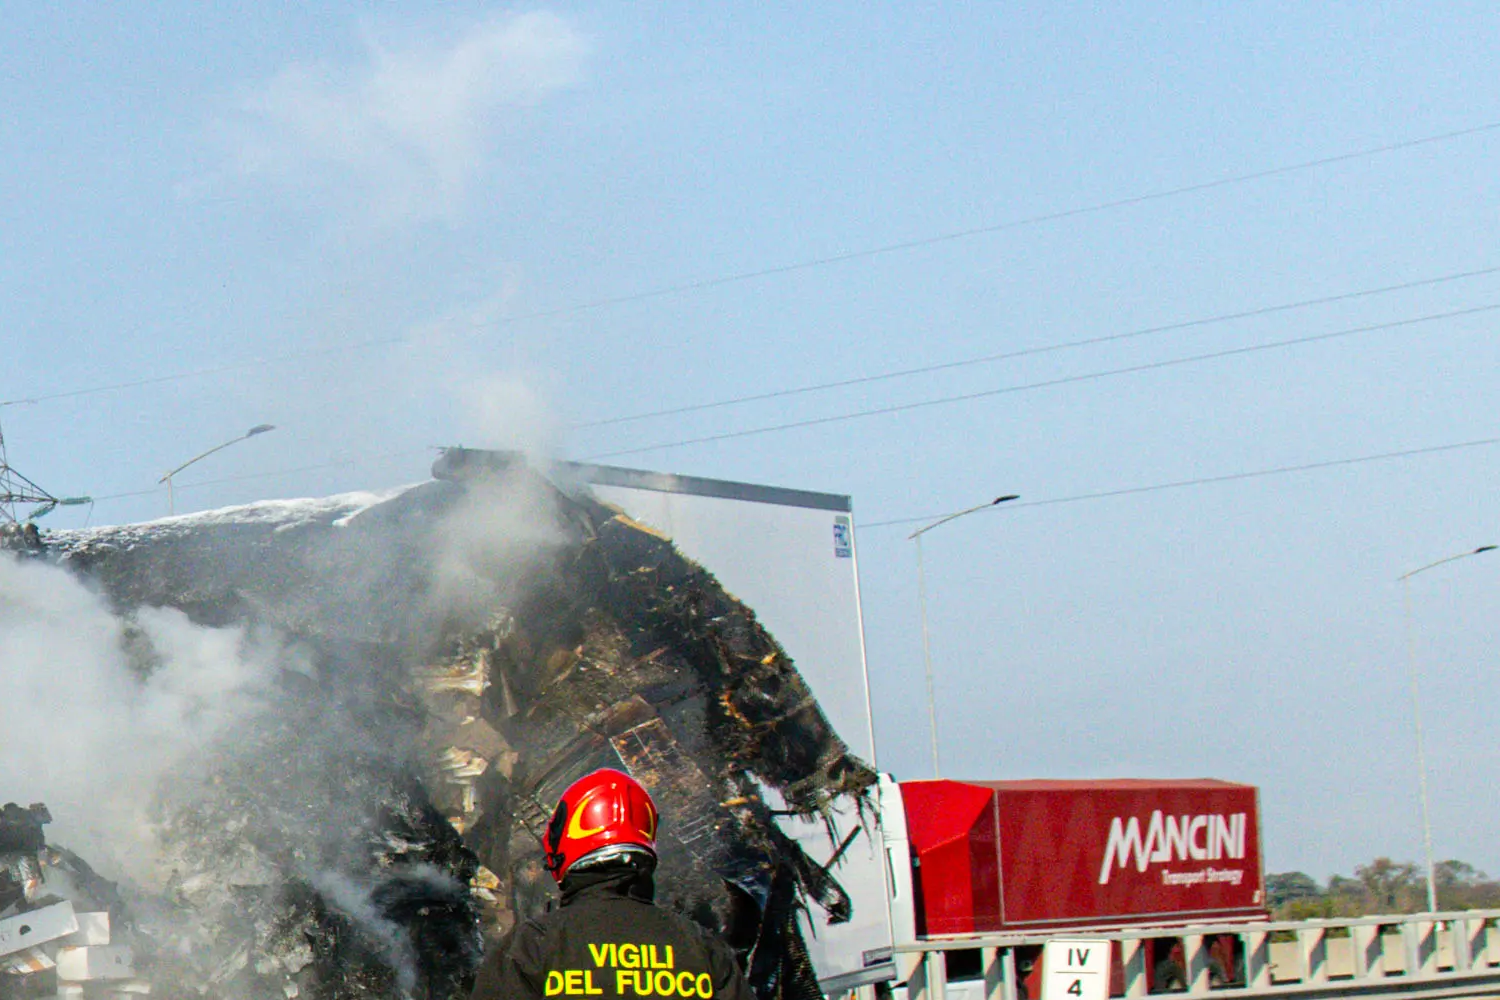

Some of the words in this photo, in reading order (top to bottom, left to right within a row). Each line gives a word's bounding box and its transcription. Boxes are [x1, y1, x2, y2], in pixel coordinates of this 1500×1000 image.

[1099, 809, 1247, 885] MANCINI
[587, 942, 675, 970] VIGILI
[1067, 947, 1092, 967] IV
[544, 969, 604, 997] DEL
[615, 969, 714, 1000] FUOCO
[1066, 979, 1084, 998] 4
